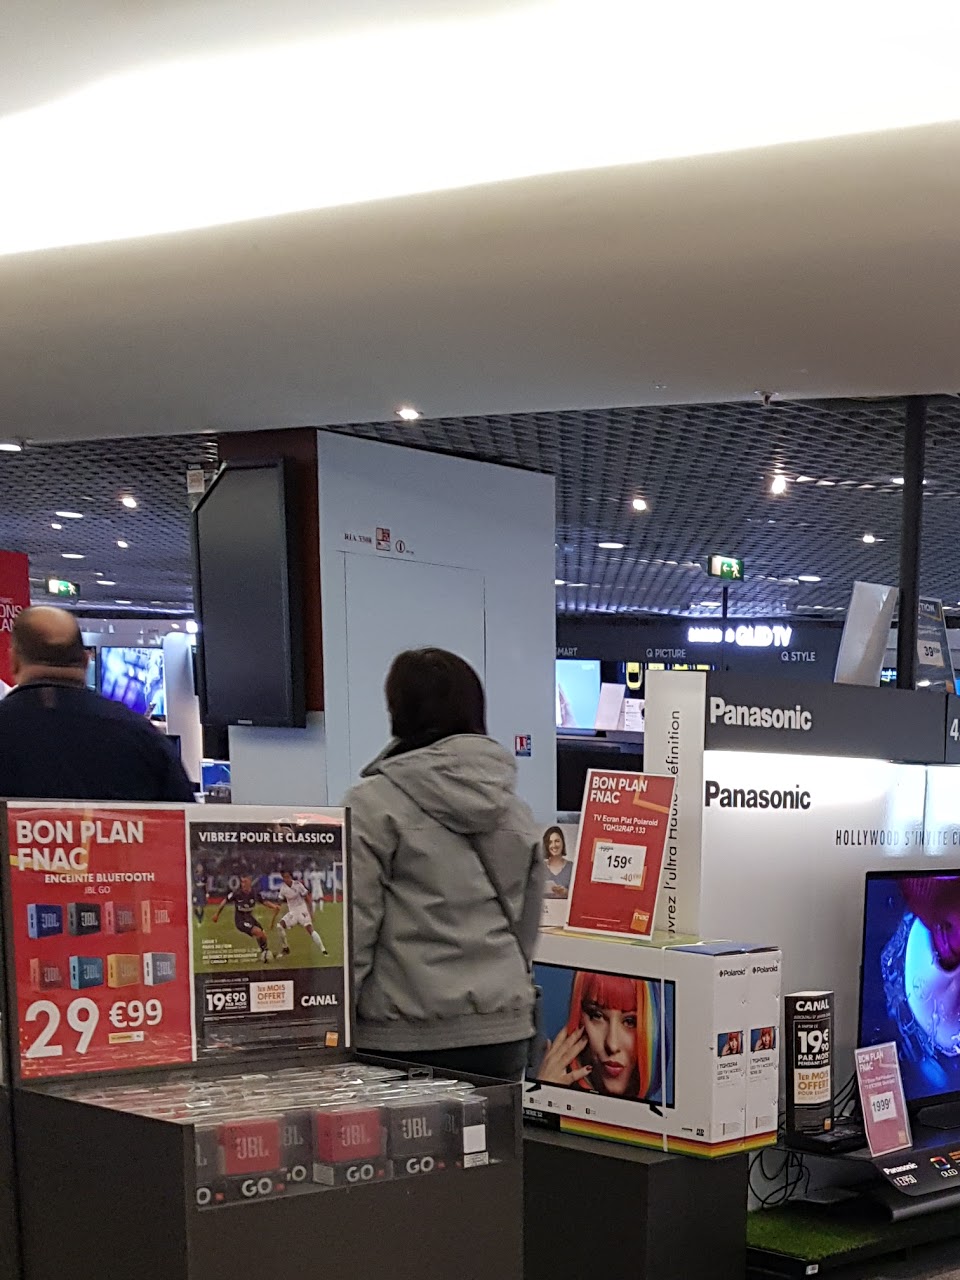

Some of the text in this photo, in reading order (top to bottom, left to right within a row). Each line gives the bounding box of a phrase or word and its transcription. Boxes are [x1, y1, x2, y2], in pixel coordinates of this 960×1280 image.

[646, 648, 686, 658] Q PICTURE
[781, 651, 816, 662] Q STYLE
[710, 696, 812, 731] Panasonic
[591, 777, 648, 792] BON PLAN
[590, 790, 621, 804] FNAC
[705, 780, 811, 810] Panasonic
[620, 816, 633, 824] Plat
[633, 817, 659, 826] Polaroid
[16, 820, 144, 845] BON PLAN
[199, 832, 335, 843] VIBREZ POUR LE CLASSICO
[835, 829, 900, 847] HOLLYWOOD
[17, 847, 89, 872] FNAC
[606, 855, 633, 869] 159€
[45, 872, 155, 884] ENCEINTE BLUETOOTH
[98, 886, 111, 894] GO
[41, 912, 60, 929] JBL
[81, 911, 98, 927] JBL
[155, 909, 171, 924] JBL
[44, 966, 62, 983] JBL
[83, 964, 101, 979] JBL
[157, 961, 173, 977] JBL
[723, 968, 746, 977] Polaroid
[756, 965, 778, 974] Polaroid
[257, 992, 286, 1001] OFFERT
[301, 994, 338, 1007] CANAL
[796, 999, 829, 1012] CANAL
[870, 1050, 884, 1061] PLAN
[859, 1062, 874, 1073] FNAC
[798, 1079, 829, 1090] OFFERT
[340, 1122, 370, 1147] JBL
[403, 1116, 432, 1139] JBL
[283, 1125, 304, 1146] BL
[235, 1136, 269, 1159] JBL
[346, 1164, 374, 1181] GO
[406, 1156, 434, 1174] GO
[883, 1162, 918, 1175] Panasonic
[940, 1168, 958, 1178] OLED
[242, 1177, 273, 1197] GO
